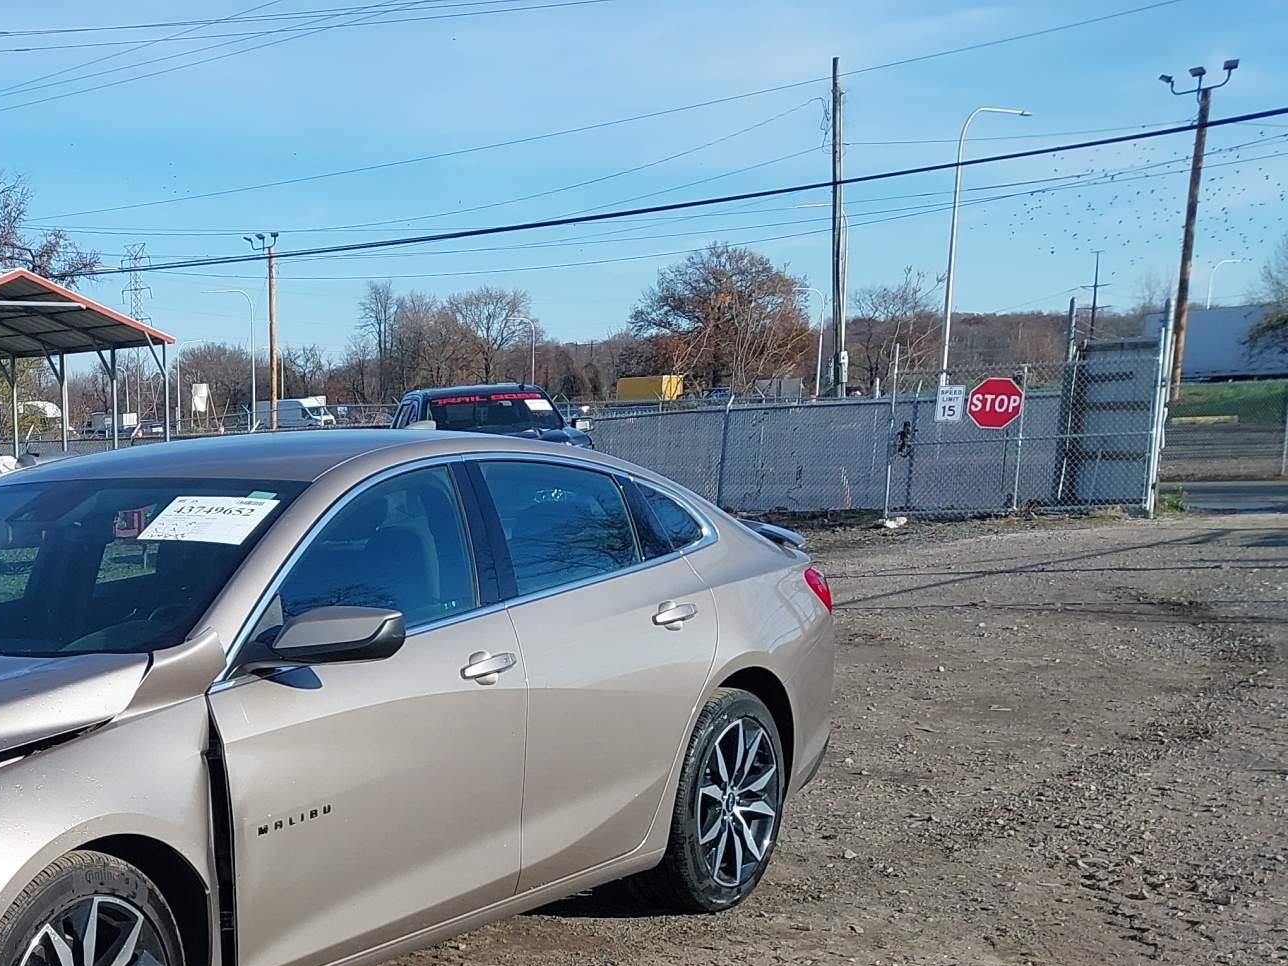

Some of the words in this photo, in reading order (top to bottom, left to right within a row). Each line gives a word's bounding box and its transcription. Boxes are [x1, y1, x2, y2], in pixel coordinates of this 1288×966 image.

[941, 405, 956, 417] 15
[970, 393, 1021, 413] STOP
[173, 505, 255, 517] 43749652
[257, 804, 332, 836] MALIBU
